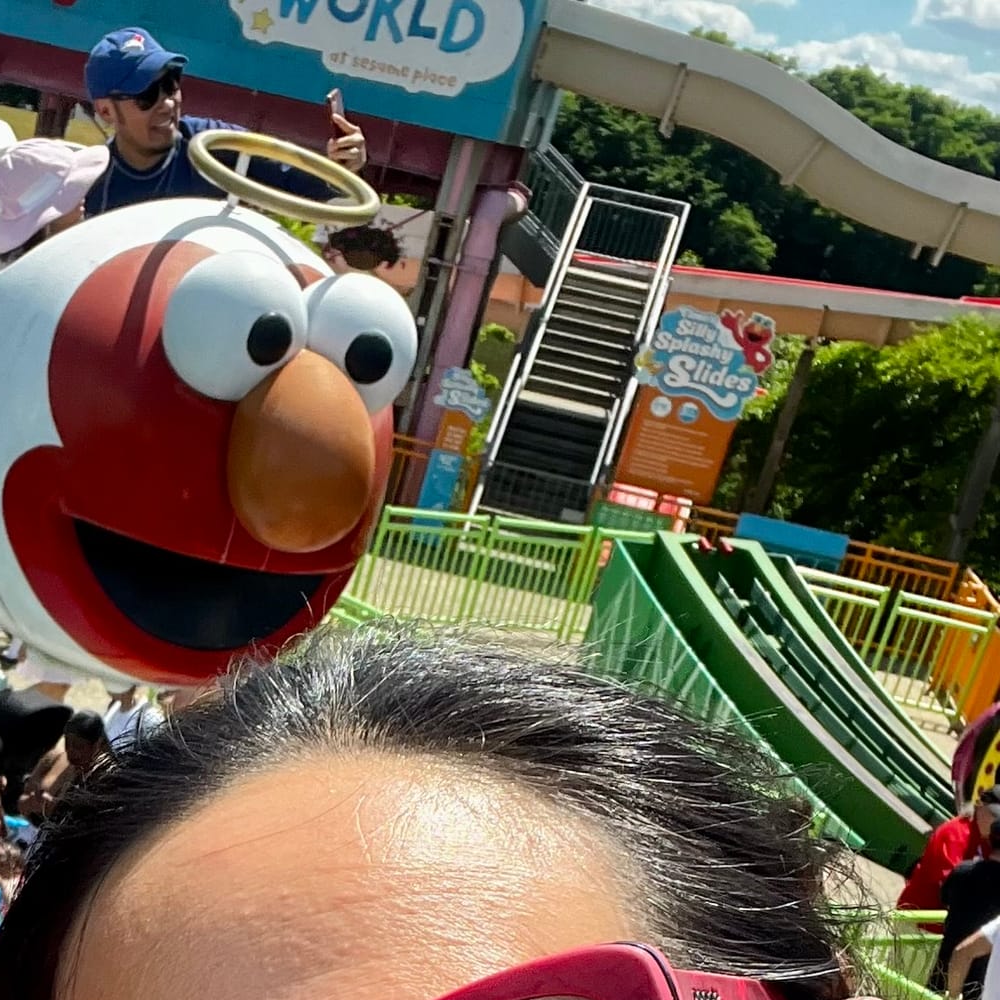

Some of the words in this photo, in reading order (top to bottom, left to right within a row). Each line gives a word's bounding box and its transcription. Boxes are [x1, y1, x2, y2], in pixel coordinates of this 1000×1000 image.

[329, 50, 347, 64] at
[352, 55, 410, 77] sesame
[412, 67, 458, 87] place
[654, 331, 734, 365] Splashy
[676, 319, 718, 343] Silly
[664, 355, 752, 407] Slides
